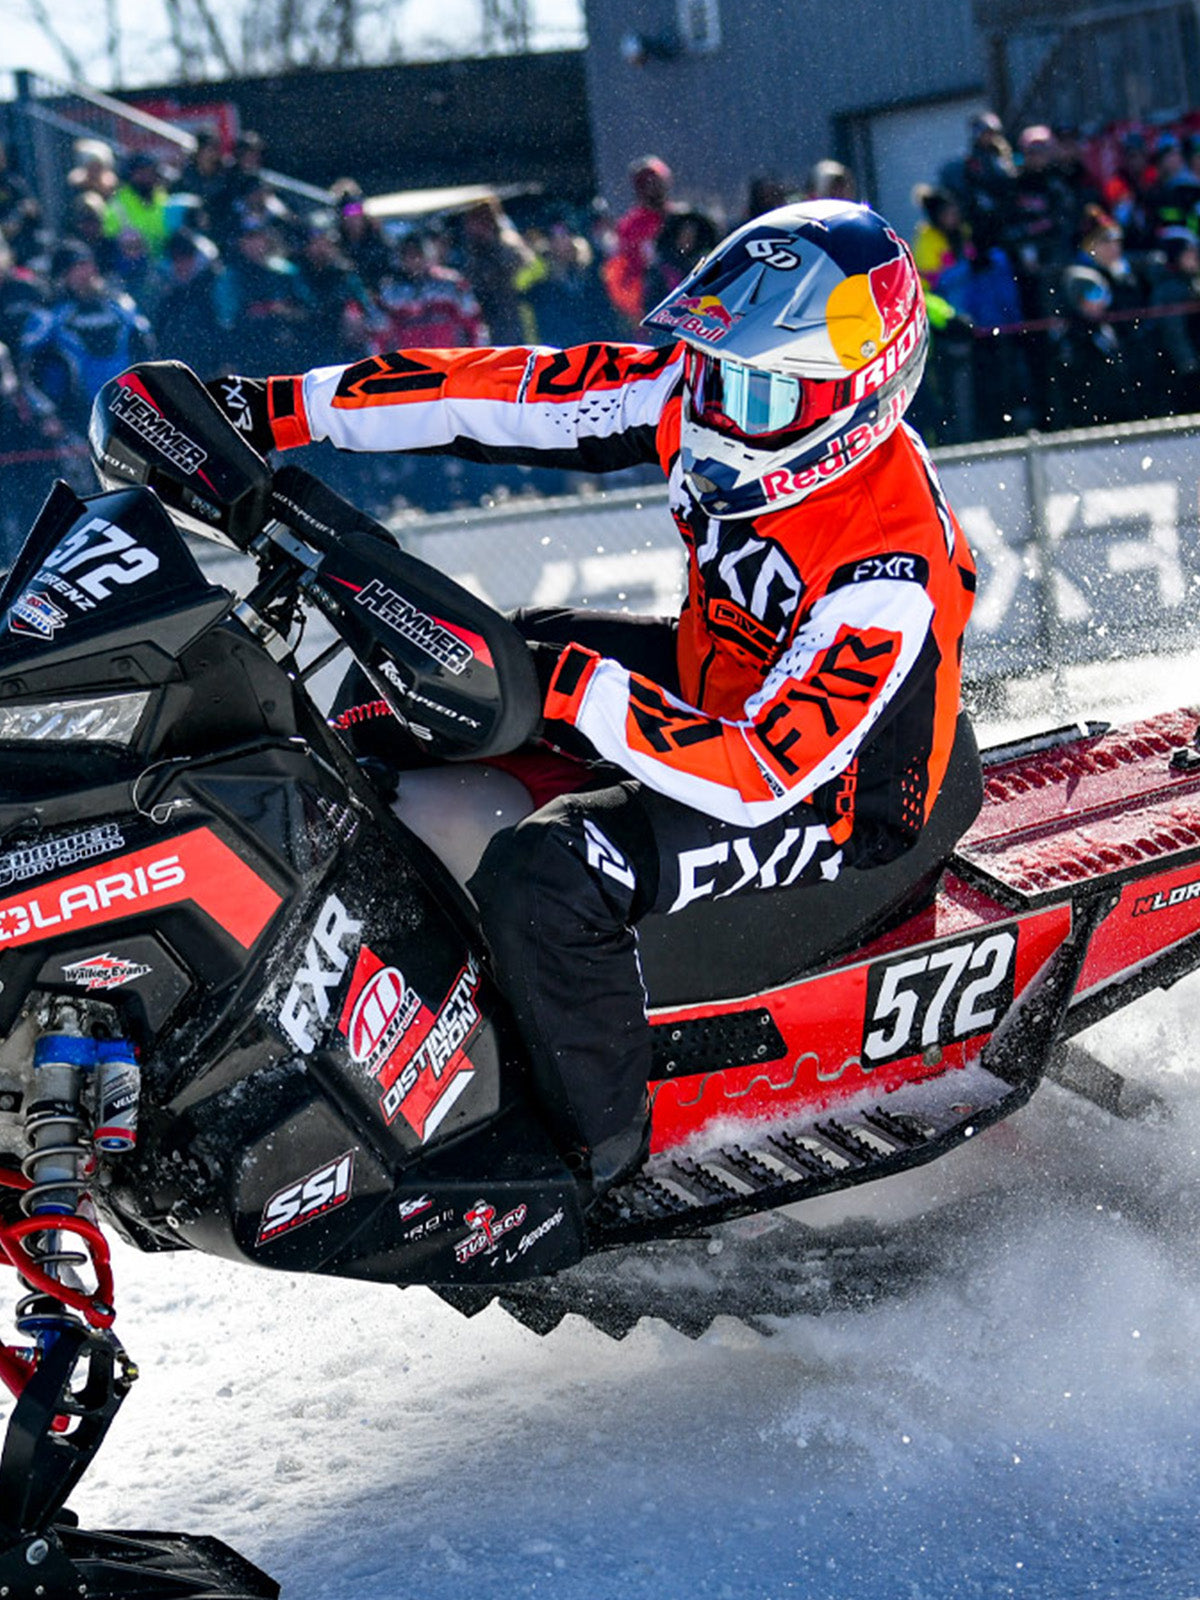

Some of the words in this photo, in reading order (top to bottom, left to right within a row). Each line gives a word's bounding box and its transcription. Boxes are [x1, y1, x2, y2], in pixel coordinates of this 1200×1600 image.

[682, 317, 728, 342] Bull
[109, 386, 207, 468] HEMMER
[221, 374, 254, 431] XR
[43, 517, 160, 601] 572
[853, 556, 915, 581] FXR
[354, 578, 474, 665] HEMMER
[407, 690, 457, 718] SPEED
[755, 634, 894, 776] FXR
[669, 824, 843, 914] FXR
[278, 894, 365, 1054] FXR
[864, 932, 1015, 1061] 572
[262, 1155, 350, 1232] SSI
